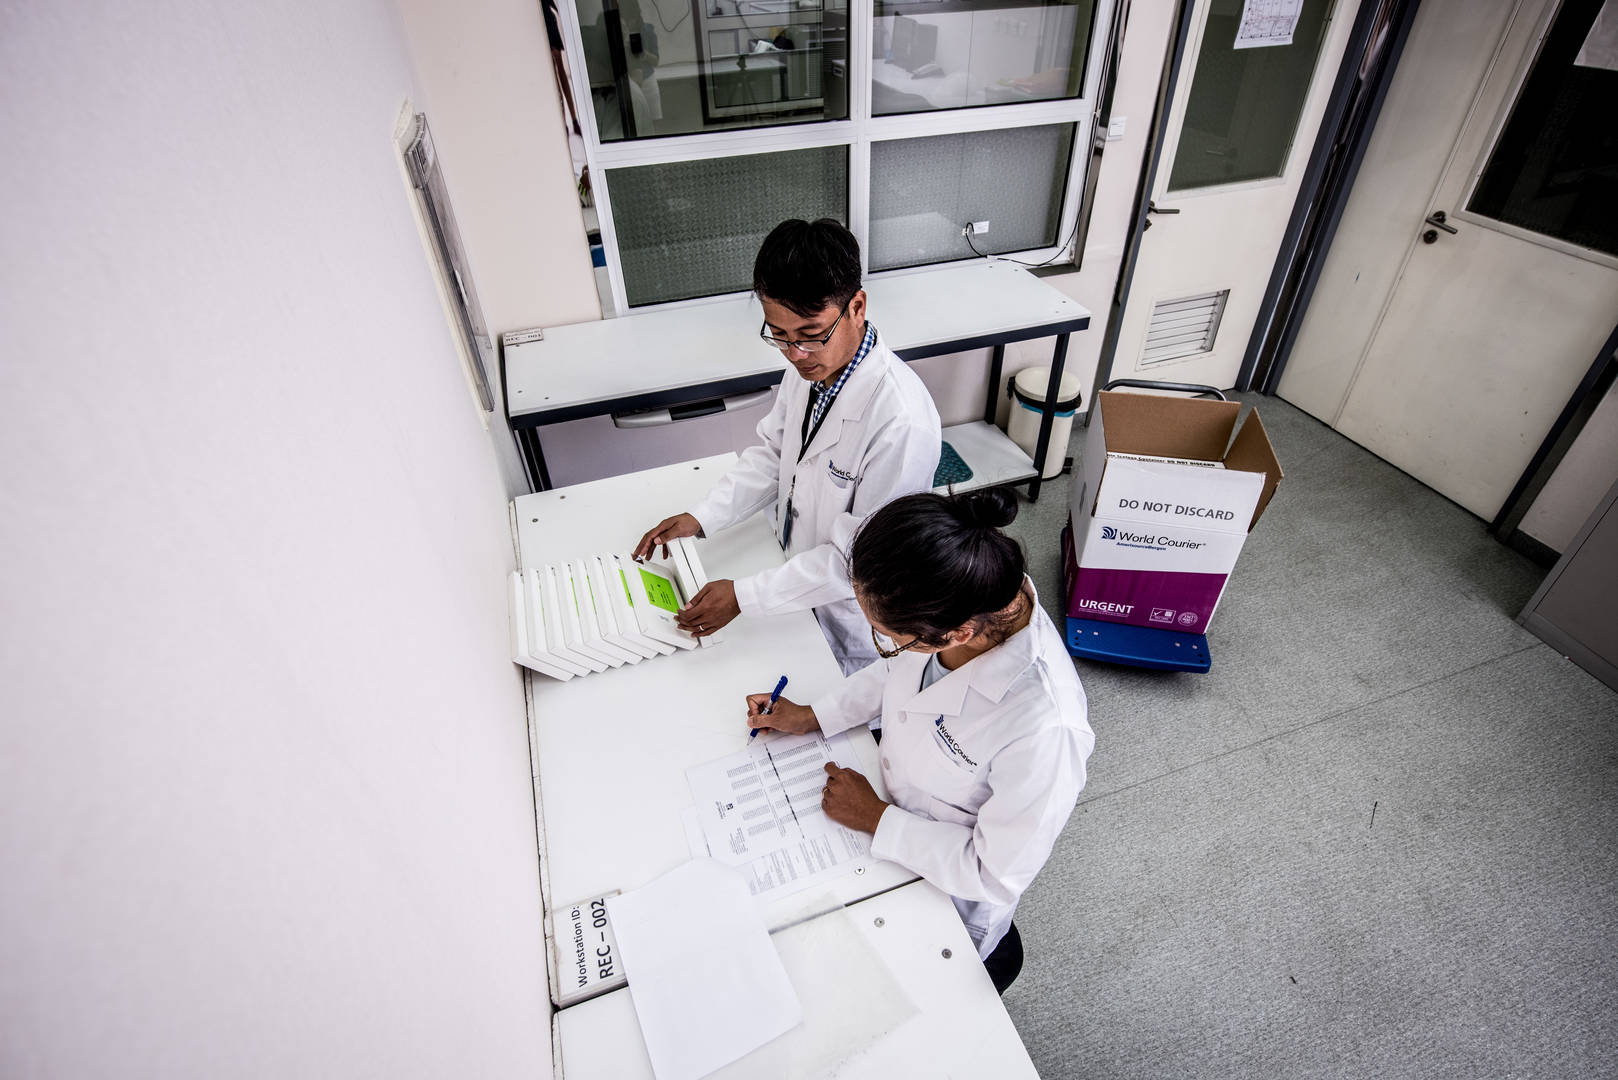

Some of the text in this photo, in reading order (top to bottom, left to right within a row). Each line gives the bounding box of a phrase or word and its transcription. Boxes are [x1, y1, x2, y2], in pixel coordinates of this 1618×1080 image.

[1119, 499, 1234, 521] DO NOT DISCARD
[1119, 531, 1202, 550] World Courier
[1079, 599, 1134, 614] URGENT
[939, 723, 955, 744] World
[590, 898, 607, 928] 002
[571, 905, 588, 988] Workstation ID:
[596, 944, 614, 980] REC
